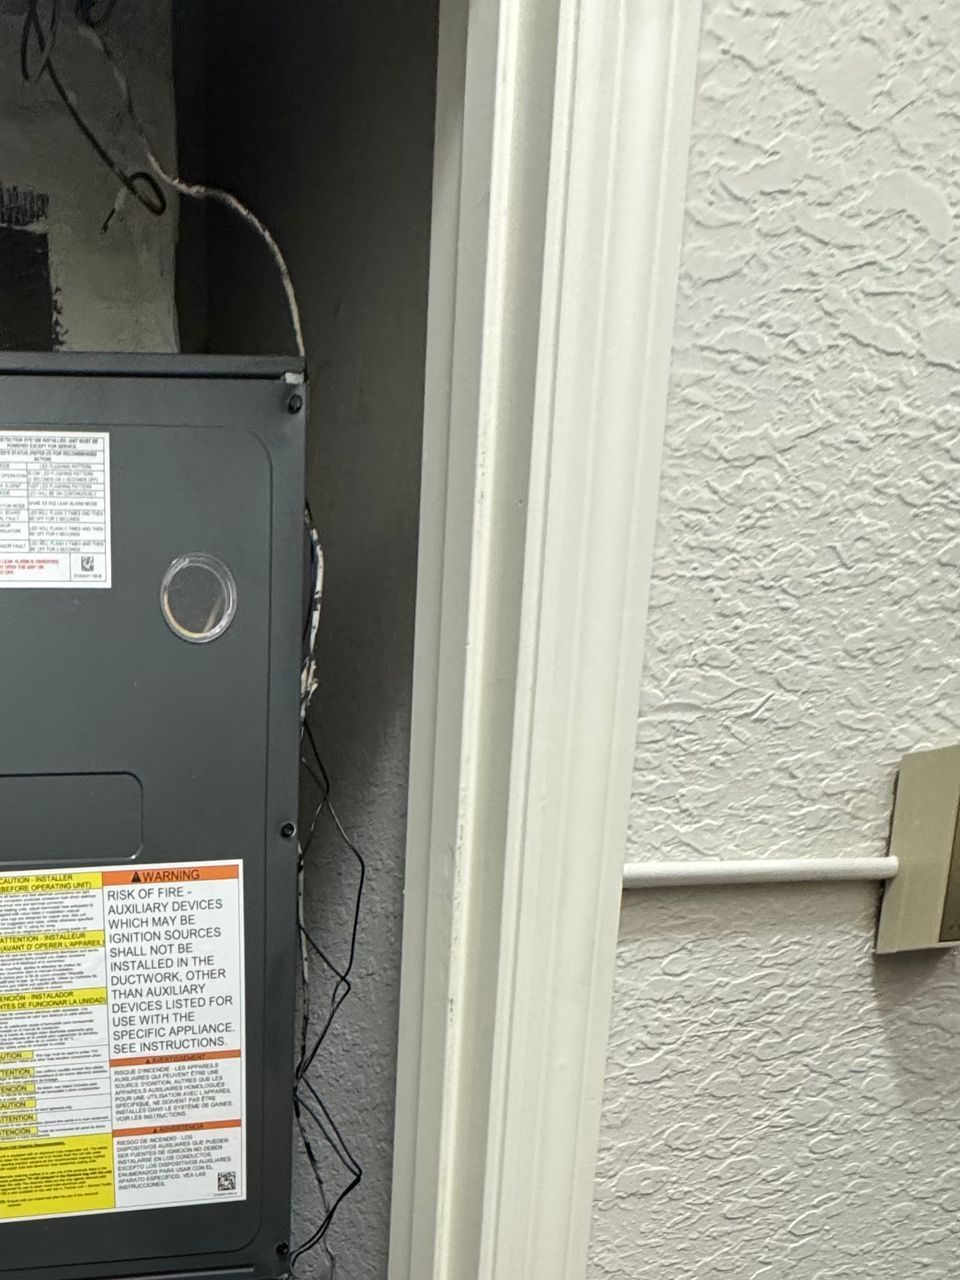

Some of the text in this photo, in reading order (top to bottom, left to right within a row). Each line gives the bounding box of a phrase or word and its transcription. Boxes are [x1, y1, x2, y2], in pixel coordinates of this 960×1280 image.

[35, 874, 72, 882] INSTALLER
[143, 869, 200, 882] WARNING
[30, 882, 71, 892] OPERATING
[72, 881, 91, 889] UNIT)
[107, 889, 135, 901] RISK
[138, 888, 154, 899] OF
[158, 886, 183, 898] FIRE
[107, 898, 222, 915] AUXILIARY DEVICES
[108, 914, 195, 929] WHICH MAY BE
[0, 935, 38, 943] ATTENTION
[44, 932, 85, 941] INSTALLEUR
[109, 927, 221, 943] IGNITION SOURCES
[0, 943, 25, 952] (AVANT
[109, 942, 193, 957] SHALL NOT BE
[110, 955, 214, 971] INSTALLED IN THE
[110, 968, 226, 987] DUCTWORK, OTHER
[30, 991, 73, 999] INSTALADOR
[111, 983, 205, 999] THAN AUXILIARY
[17, 1001, 26, 1009] DE
[29, 999, 67, 1008] FUNCIONAR
[111, 995, 233, 1013] DEVICES LISTED FOR
[112, 1011, 195, 1027] USE WITH THE
[113, 1022, 235, 1040] SPECIFIC APPLIANCE.
[113, 1036, 227, 1054] SEE INSTRUCTIONS.
